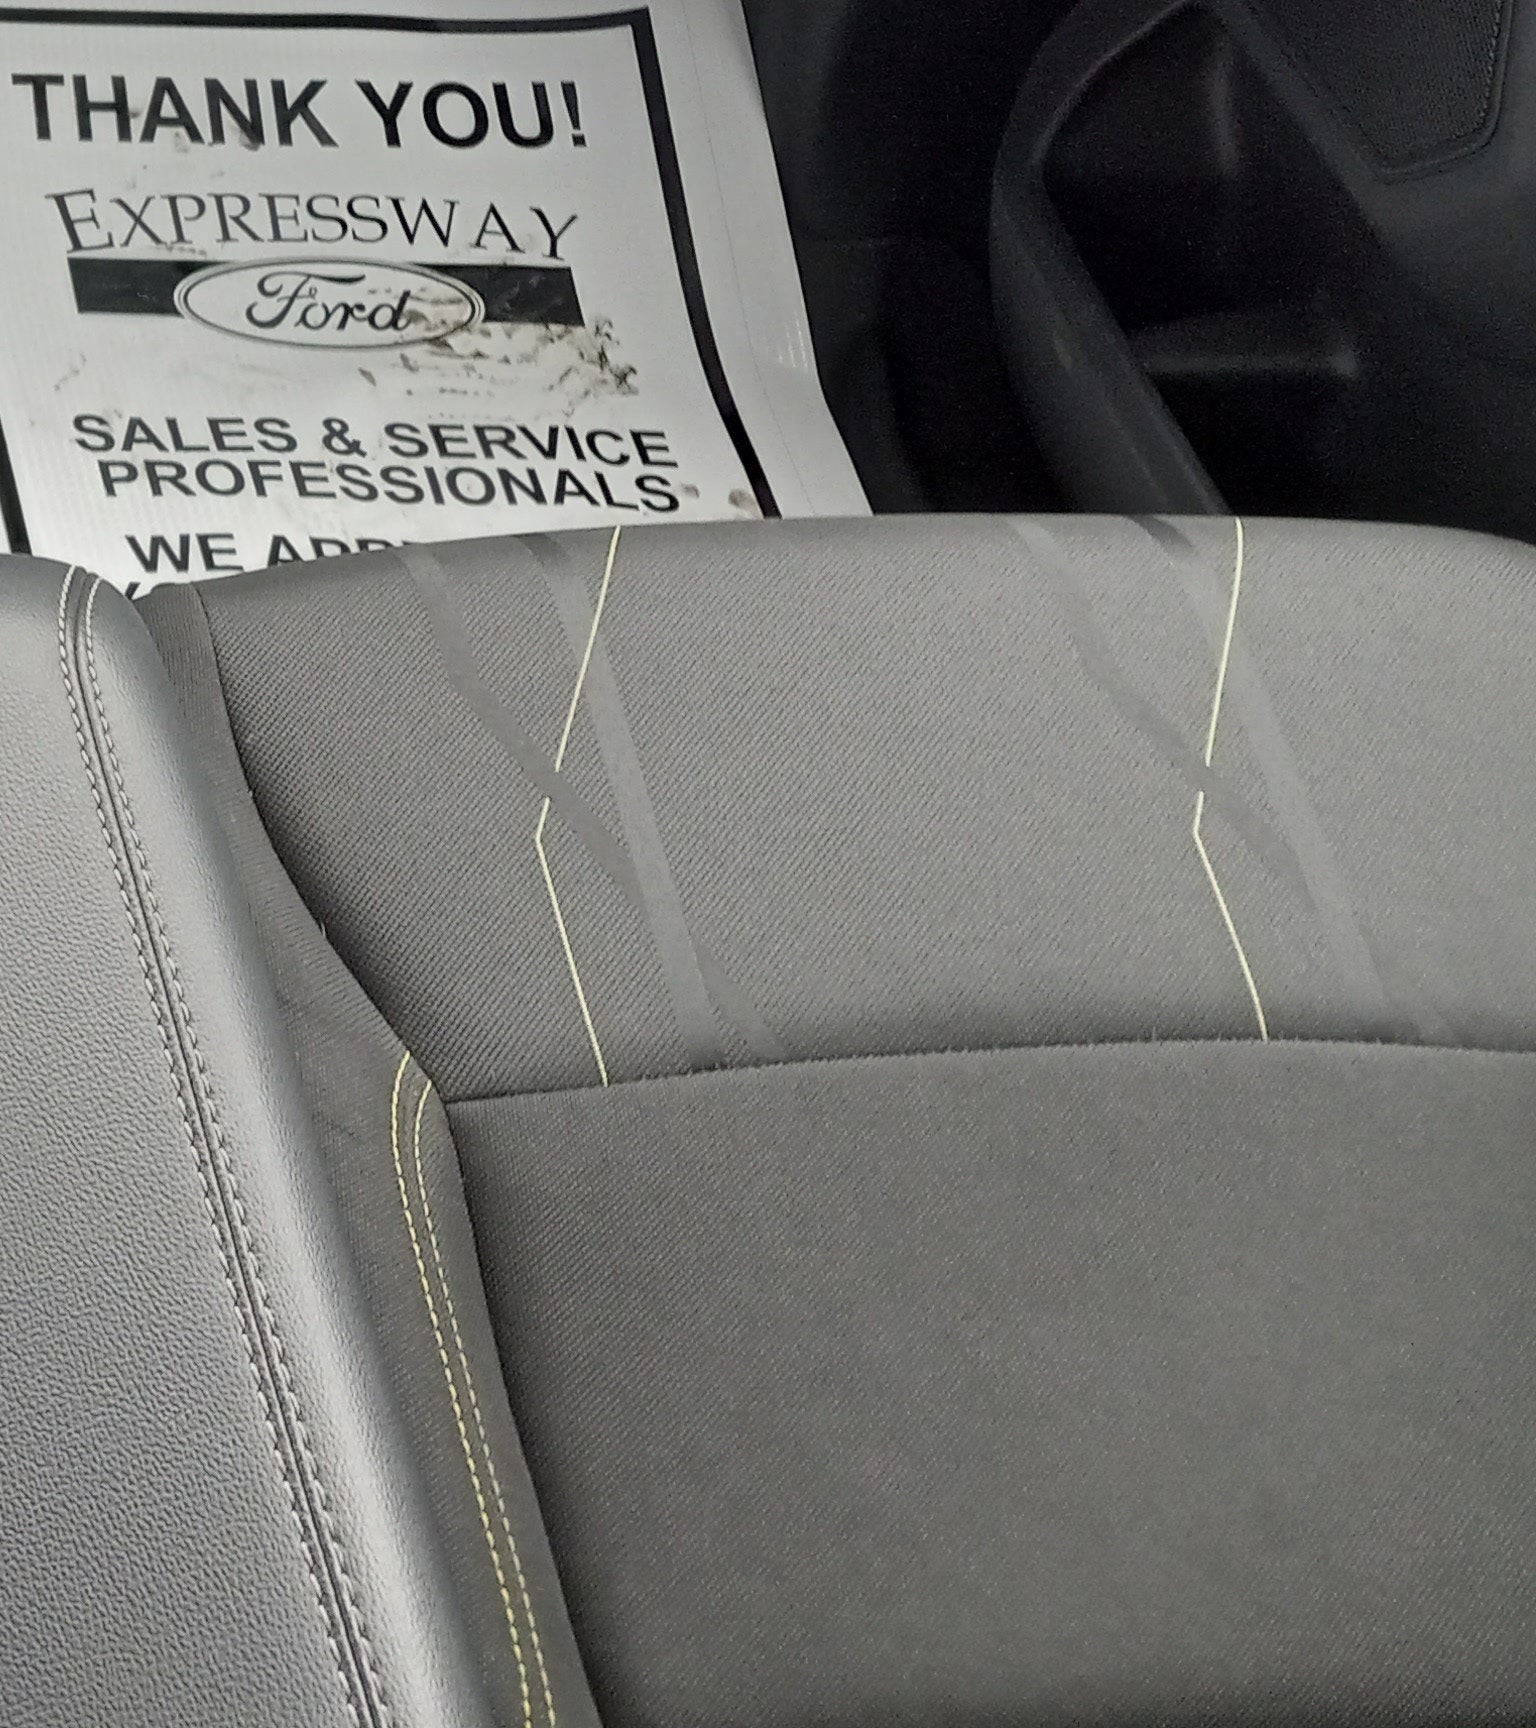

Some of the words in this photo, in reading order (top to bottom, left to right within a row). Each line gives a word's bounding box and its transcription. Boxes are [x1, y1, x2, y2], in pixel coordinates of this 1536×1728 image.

[11, 74, 339, 147] THANK
[355, 80, 589, 149] YOU!
[244, 271, 412, 333] Ford
[73, 413, 297, 456] SALES
[322, 420, 364, 459] &
[382, 422, 680, 470] SERVICE
[97, 459, 682, 515] PROFESSIONALS
[125, 532, 244, 573] WE
